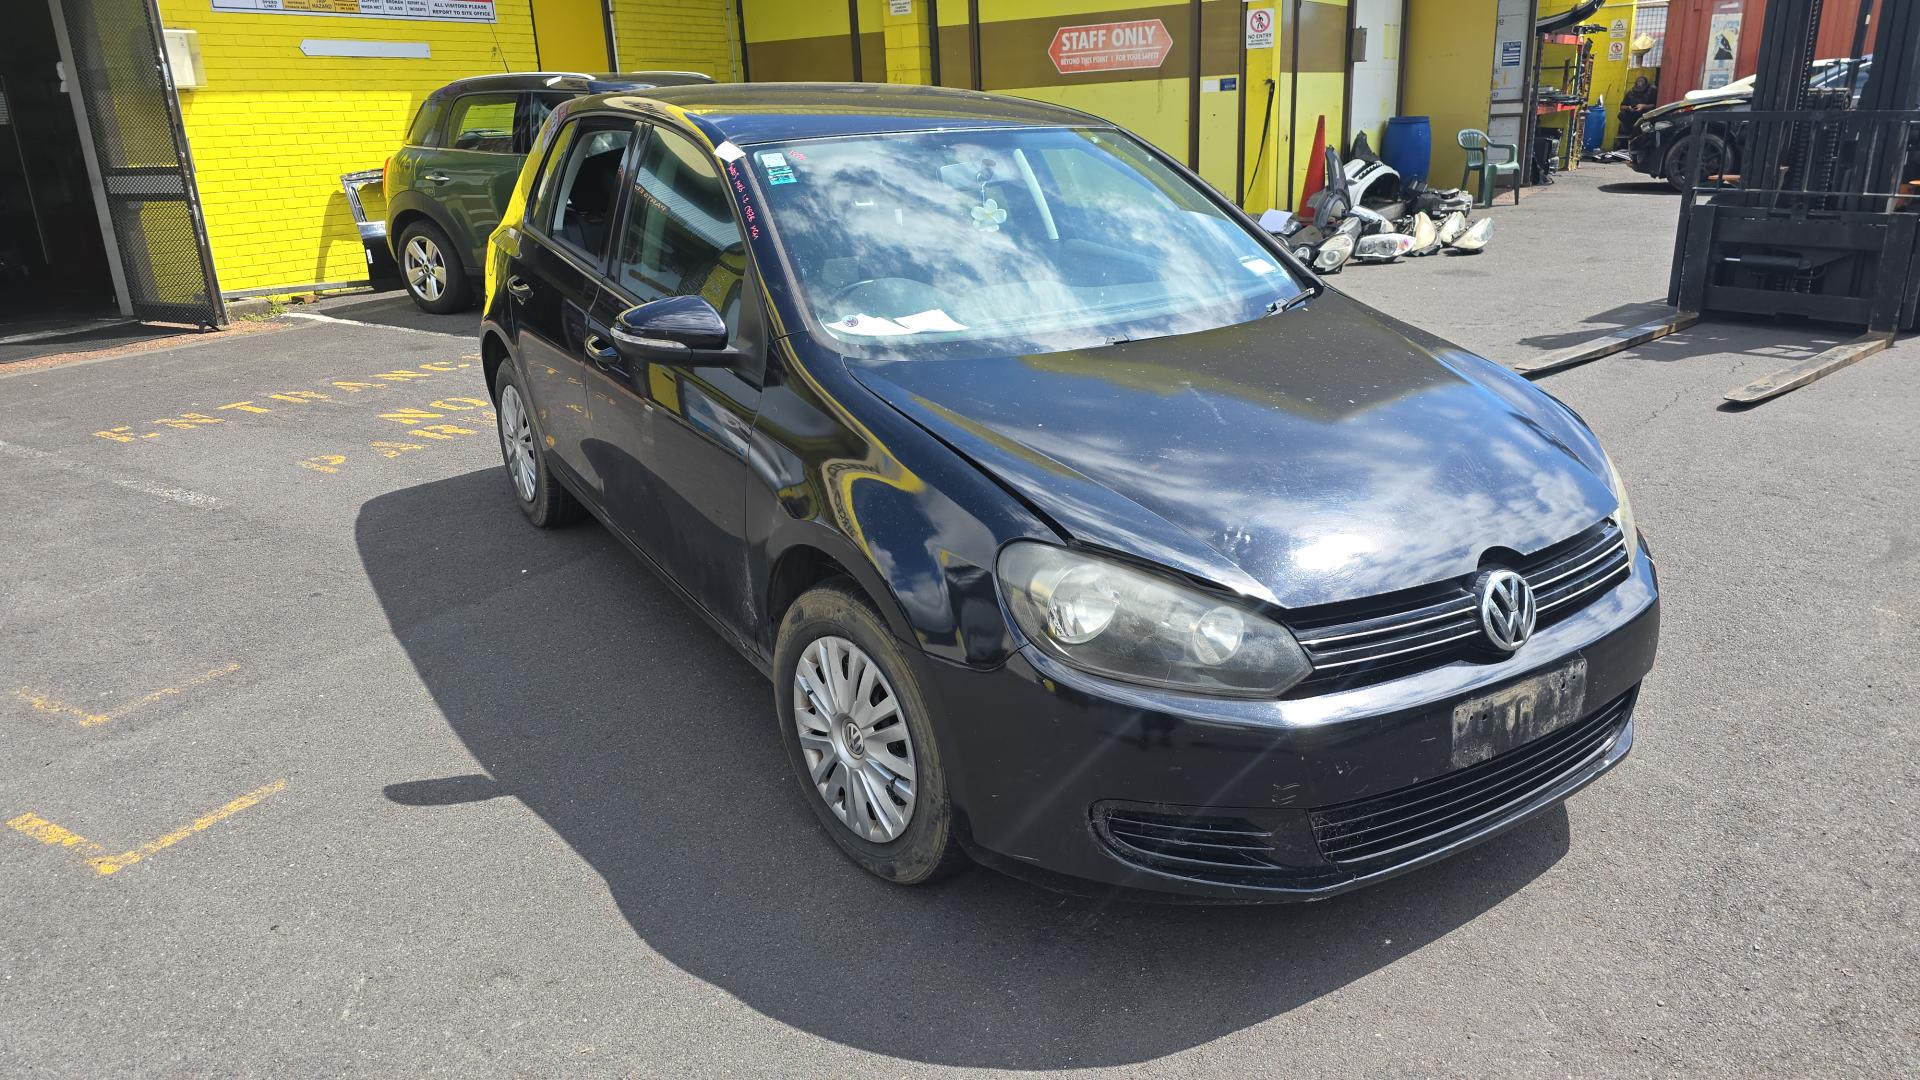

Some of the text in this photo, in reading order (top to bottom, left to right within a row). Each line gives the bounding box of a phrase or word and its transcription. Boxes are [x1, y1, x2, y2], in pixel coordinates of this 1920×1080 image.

[1061, 25, 1156, 51] STAFF ONLY
[1060, 51, 1159, 66] BEYOND THIS POINT FOR YOUR SAFETY
[376, 395, 488, 424] NO
